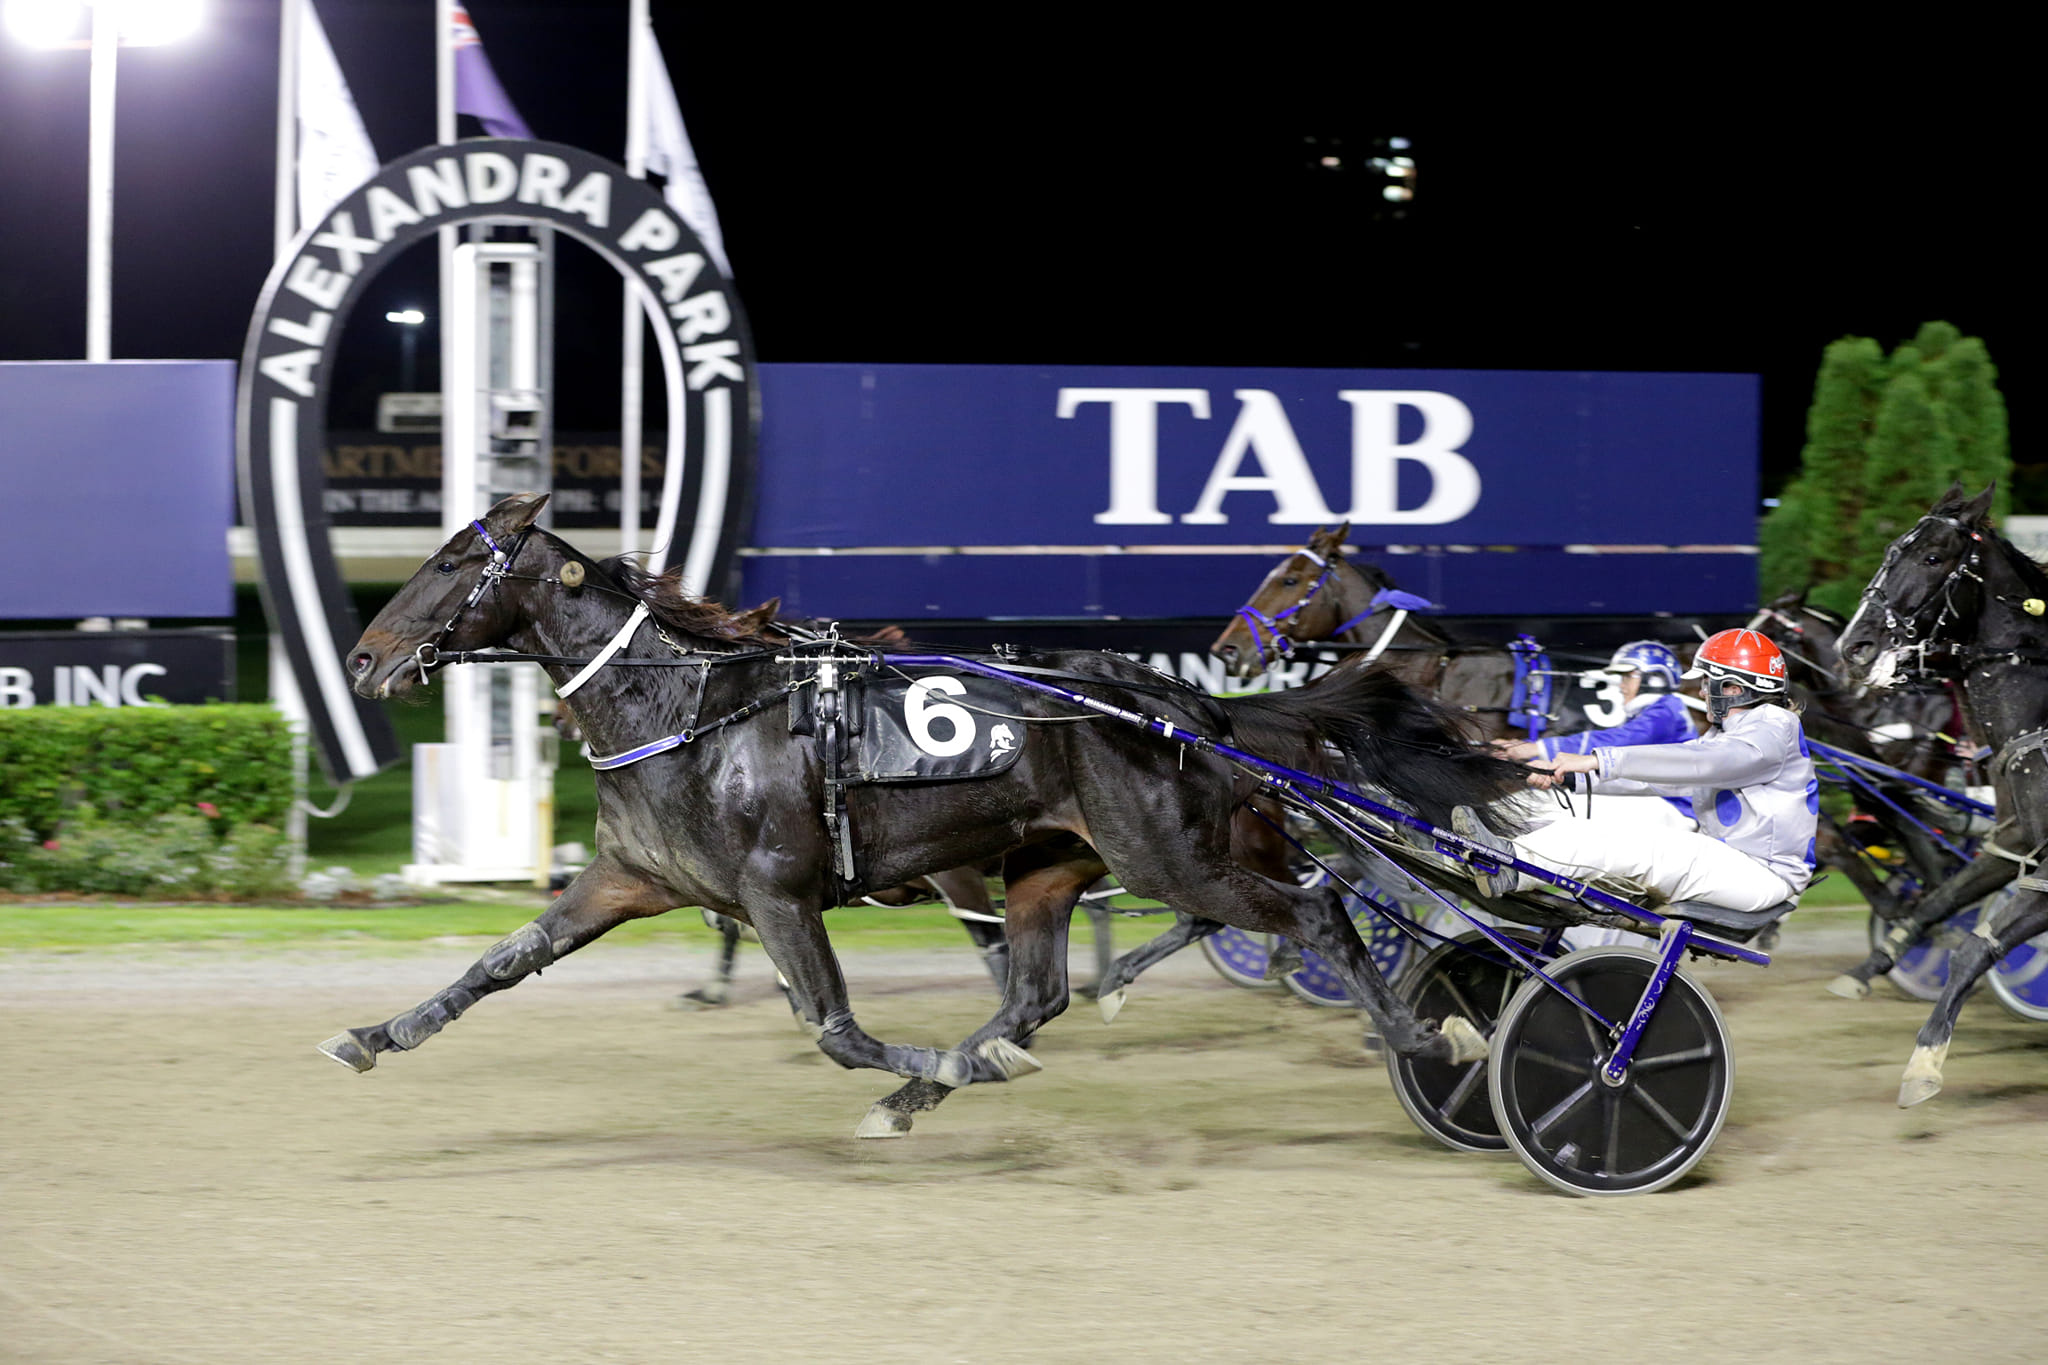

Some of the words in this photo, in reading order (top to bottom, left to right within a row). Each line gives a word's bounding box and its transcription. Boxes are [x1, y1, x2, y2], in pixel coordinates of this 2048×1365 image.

[260, 152, 612, 398] ALEXANDRA
[617, 207, 745, 391] PARK
[1056, 387, 1482, 525] TAB
[54, 663, 170, 708] INC
[904, 675, 976, 757] 6
[1580, 669, 1626, 727] 3
